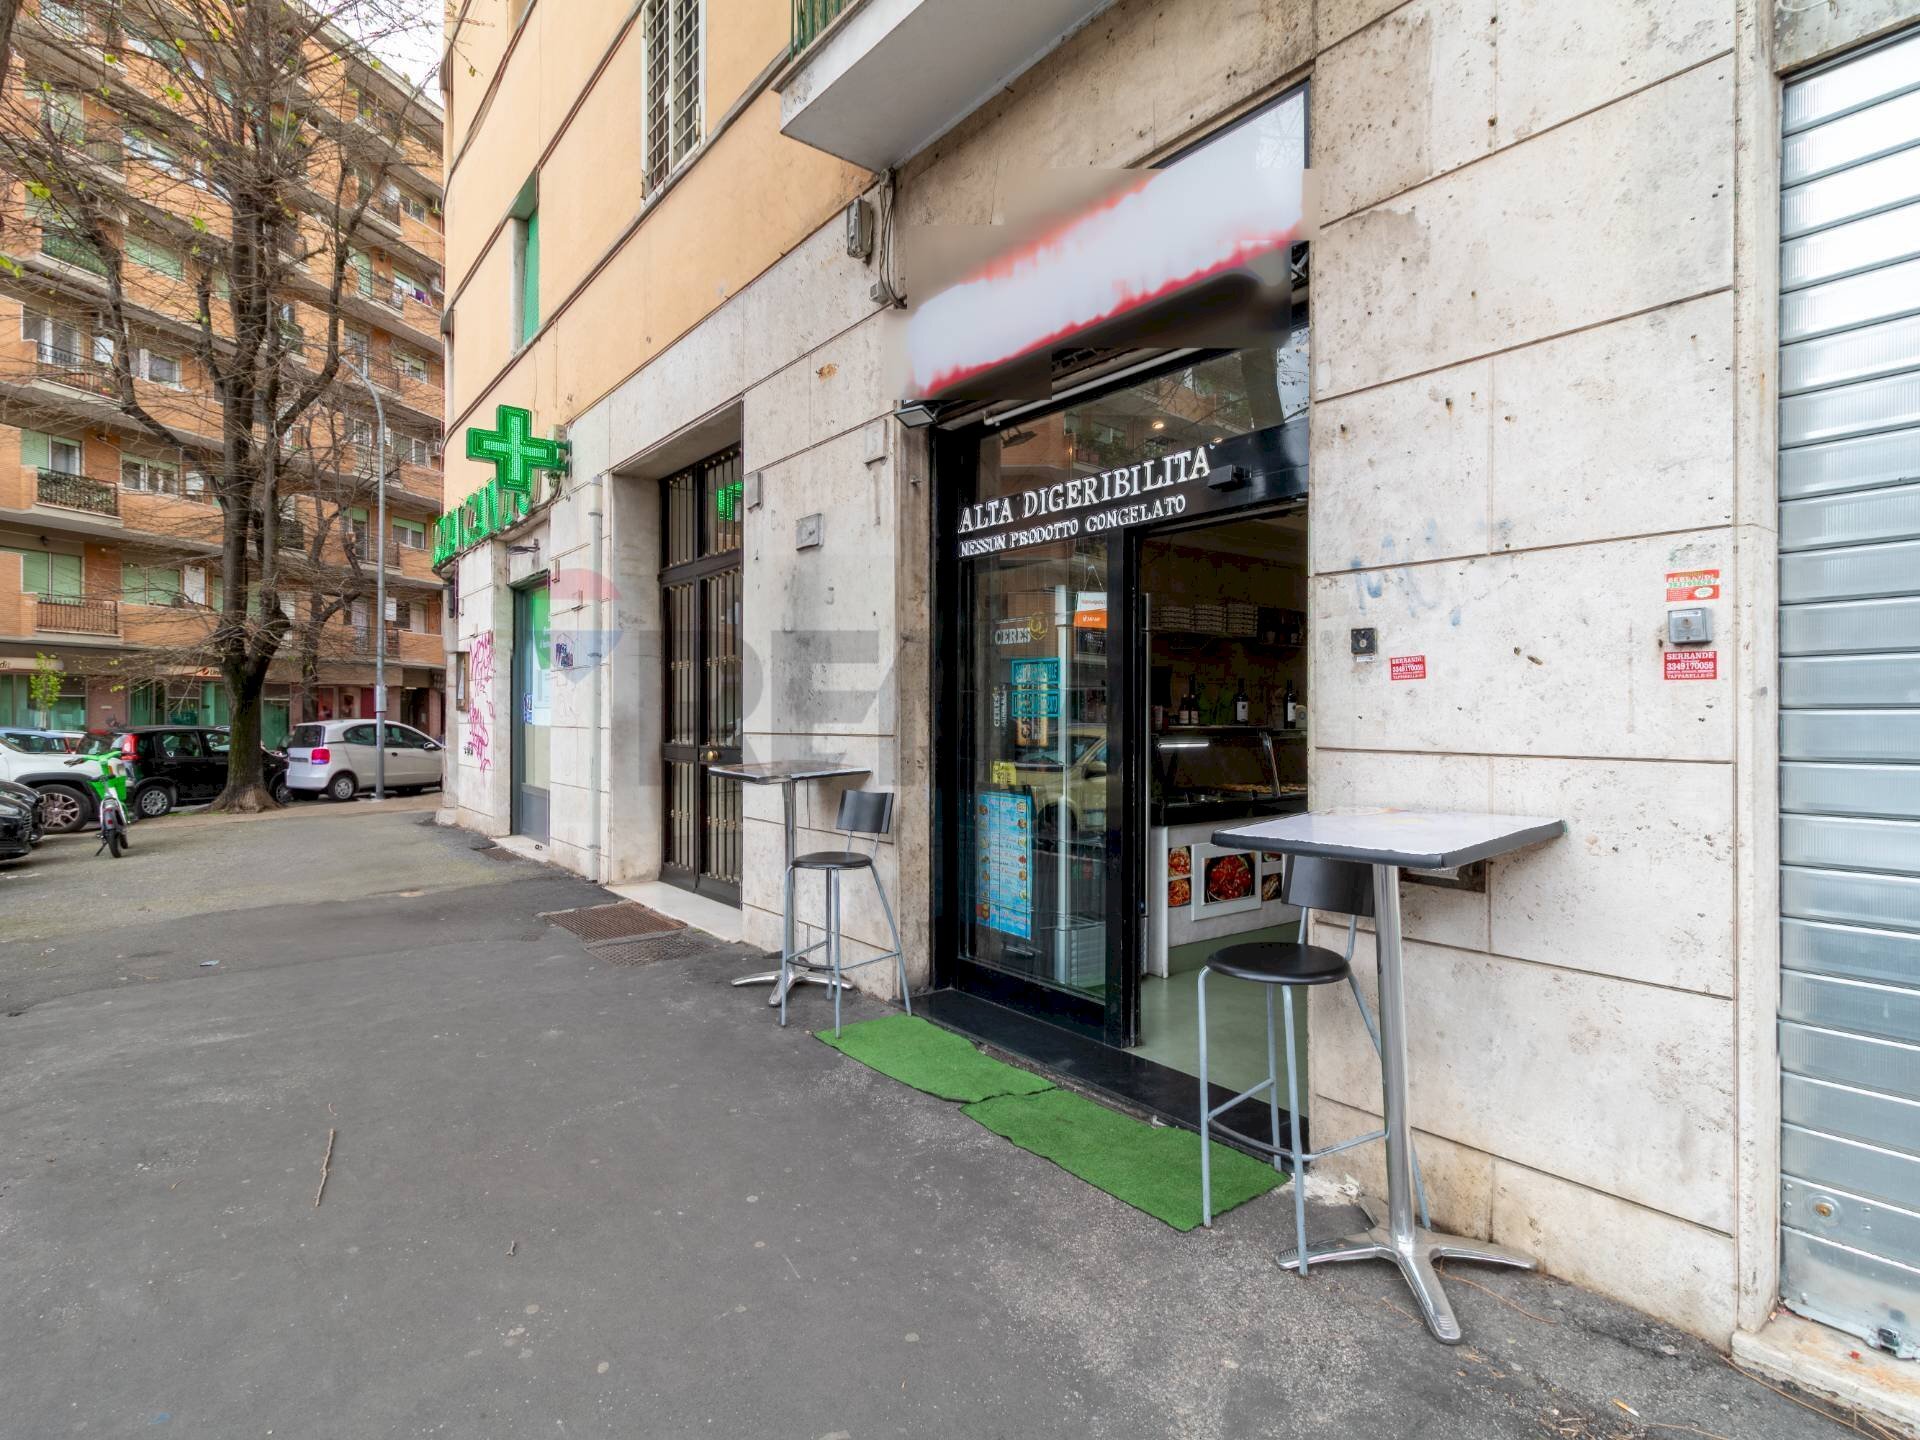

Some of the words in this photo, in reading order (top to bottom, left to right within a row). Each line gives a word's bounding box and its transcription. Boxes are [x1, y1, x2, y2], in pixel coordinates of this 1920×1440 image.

[958, 498, 1014, 534] ALTA
[959, 533, 1007, 559] NESSUN
[1009, 518, 1079, 548] PRODOTTO
[1085, 494, 1187, 532] CONGELATO
[995, 627, 1032, 645] CERES
[1666, 651, 1715, 660] SERRANDE
